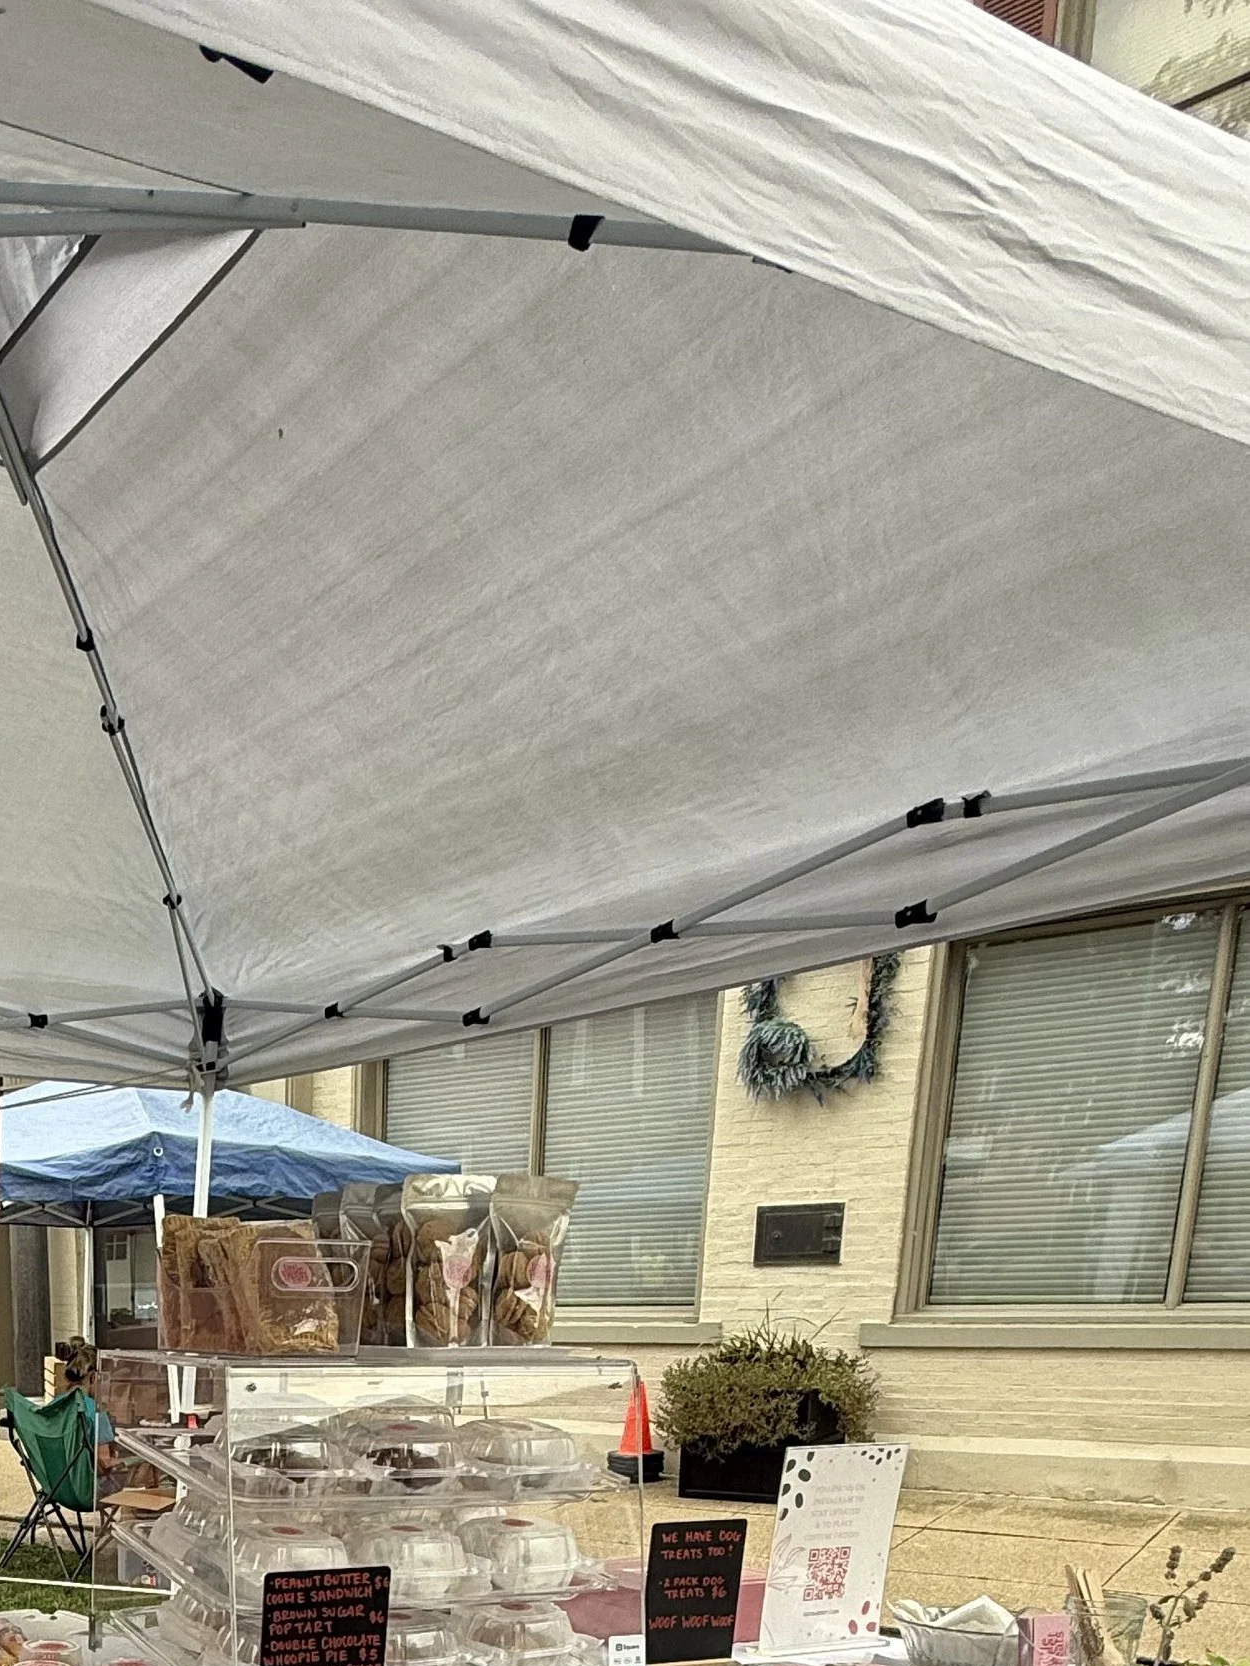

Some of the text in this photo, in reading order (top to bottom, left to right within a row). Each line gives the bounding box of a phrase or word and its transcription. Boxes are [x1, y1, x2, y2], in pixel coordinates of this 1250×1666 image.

[662, 1530, 742, 1543] WE HAVE DOG
[660, 1548, 703, 1560] TREATS
[324, 1572, 371, 1586] BUTTER
[673, 1577, 699, 1587] PACK
[702, 1577, 725, 1586] DOG
[267, 1586, 372, 1605] COOKIE SANDWICH
[664, 1585, 727, 1599] TREATS $6
[322, 1604, 365, 1618] SUGAR
[370, 1610, 385, 1624] $6
[648, 1614, 735, 1629] WOOF WOOF WOOF
[322, 1634, 381, 1649] CHOCOLATE
[263, 1648, 378, 1666] WHOOPIE PIE $5
